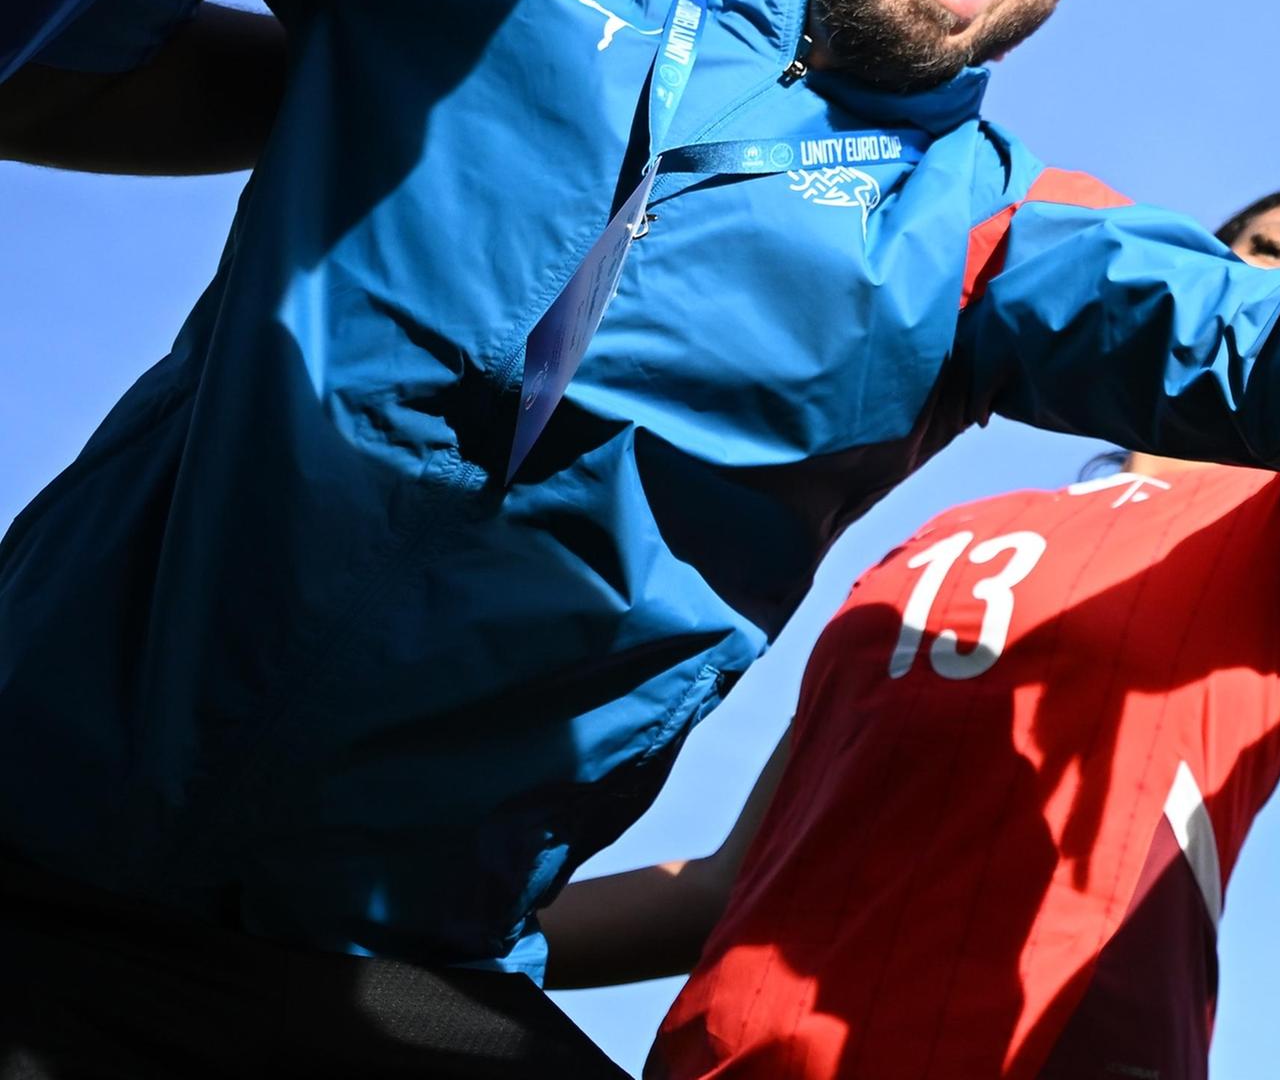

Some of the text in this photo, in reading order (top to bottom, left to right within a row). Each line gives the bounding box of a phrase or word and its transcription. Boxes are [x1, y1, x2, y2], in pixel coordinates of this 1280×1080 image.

[664, 23, 697, 65] UNITY
[800, 137, 846, 166] UNITY
[844, 135, 881, 162] EURO
[879, 134, 903, 160] CUP
[888, 529, 1046, 680] 13
